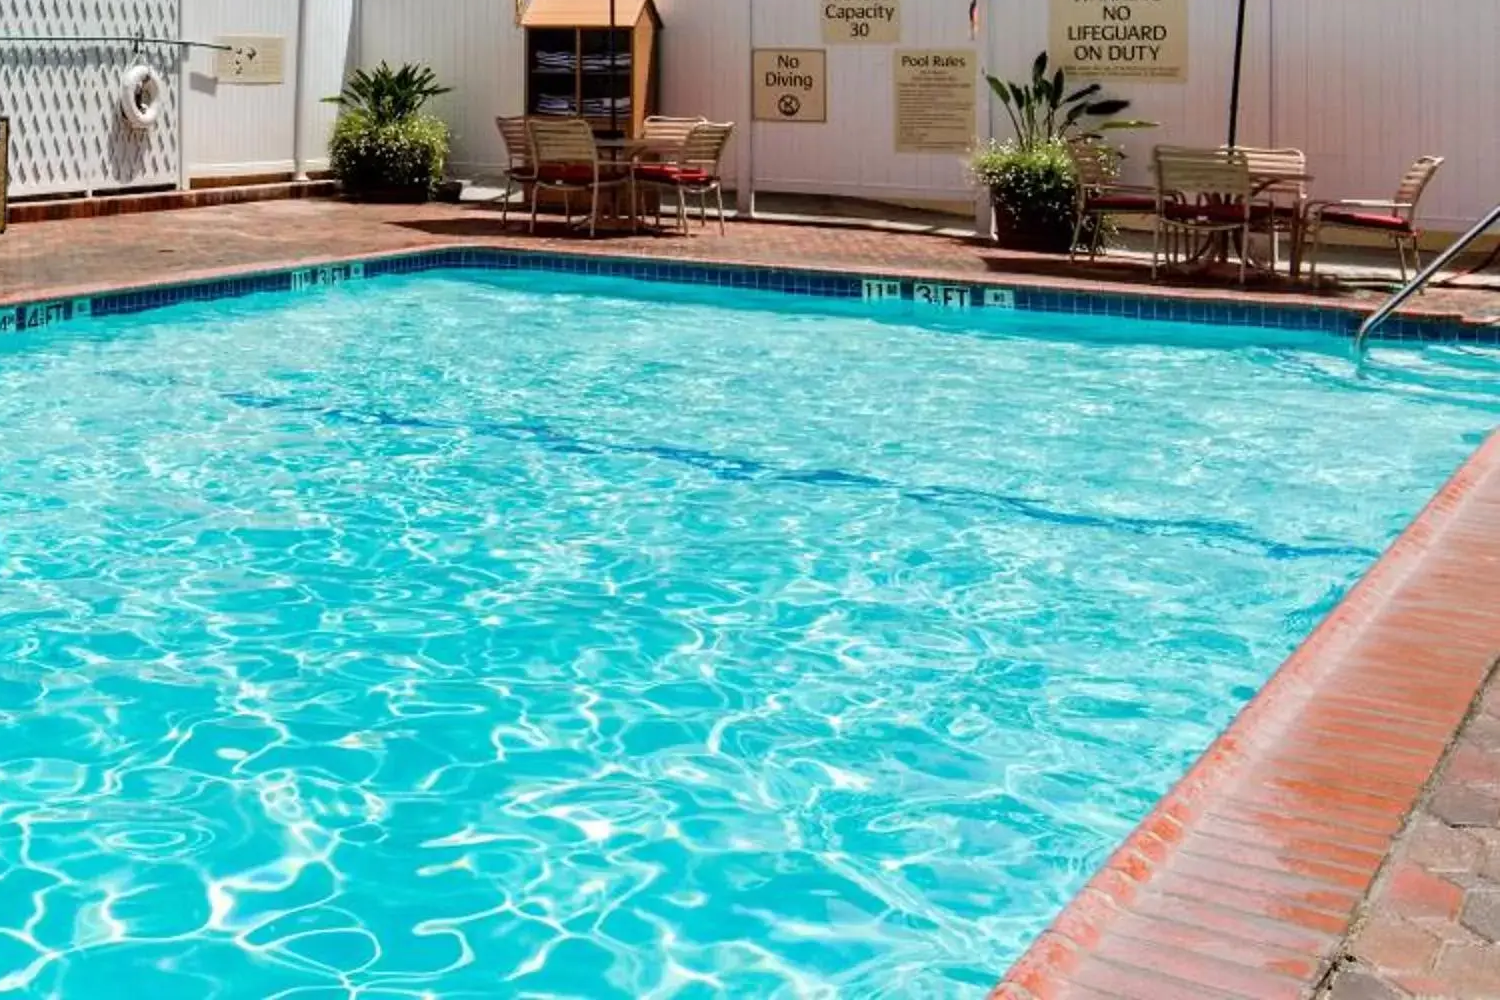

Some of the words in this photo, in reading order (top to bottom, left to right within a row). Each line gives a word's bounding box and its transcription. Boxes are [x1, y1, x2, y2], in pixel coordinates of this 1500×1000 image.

[825, 3, 895, 22] Capacity
[1102, 5, 1131, 20] NO
[851, 22, 869, 37] 30
[1067, 25, 1167, 41] LIFEGUARD
[901, 55, 929, 67] Pool
[932, 55, 966, 67] Rules
[1073, 45, 1102, 61] ON
[1108, 45, 1160, 61] DUTY
[777, 55, 799, 69] No
[765, 71, 813, 91] Diving
[943, 288, 970, 307] FT
